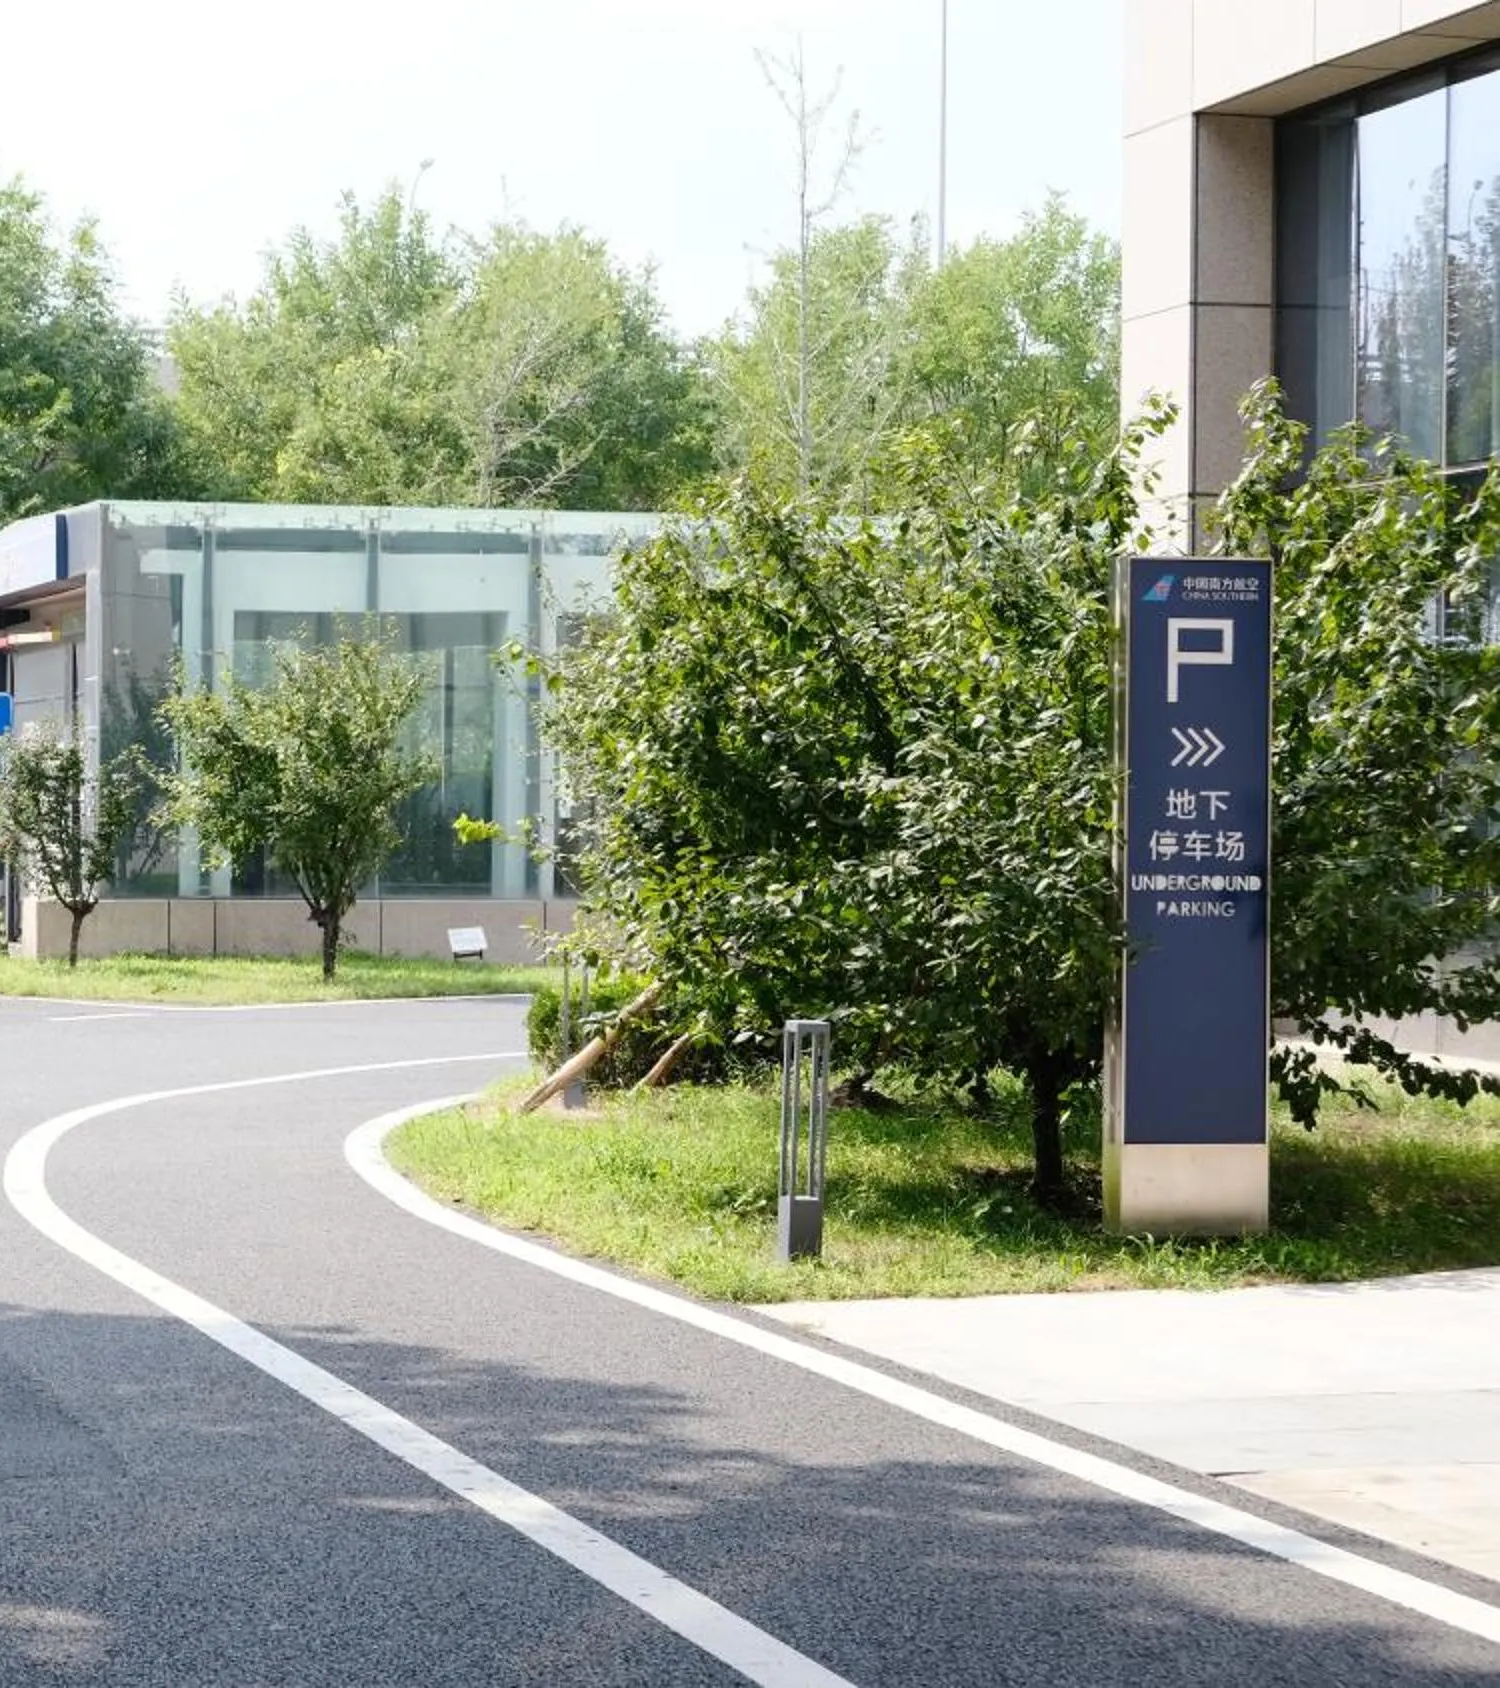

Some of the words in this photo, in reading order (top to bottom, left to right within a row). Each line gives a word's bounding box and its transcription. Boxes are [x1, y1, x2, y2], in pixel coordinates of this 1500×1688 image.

[1183, 576, 1259, 591] 中国南方航空
[1167, 617, 1234, 703] P
[1165, 788, 1231, 821] 地下
[1149, 829, 1245, 861] 停车场
[1131, 874, 1262, 892] UNDERGROUND
[1156, 901, 1236, 917] PARKING
